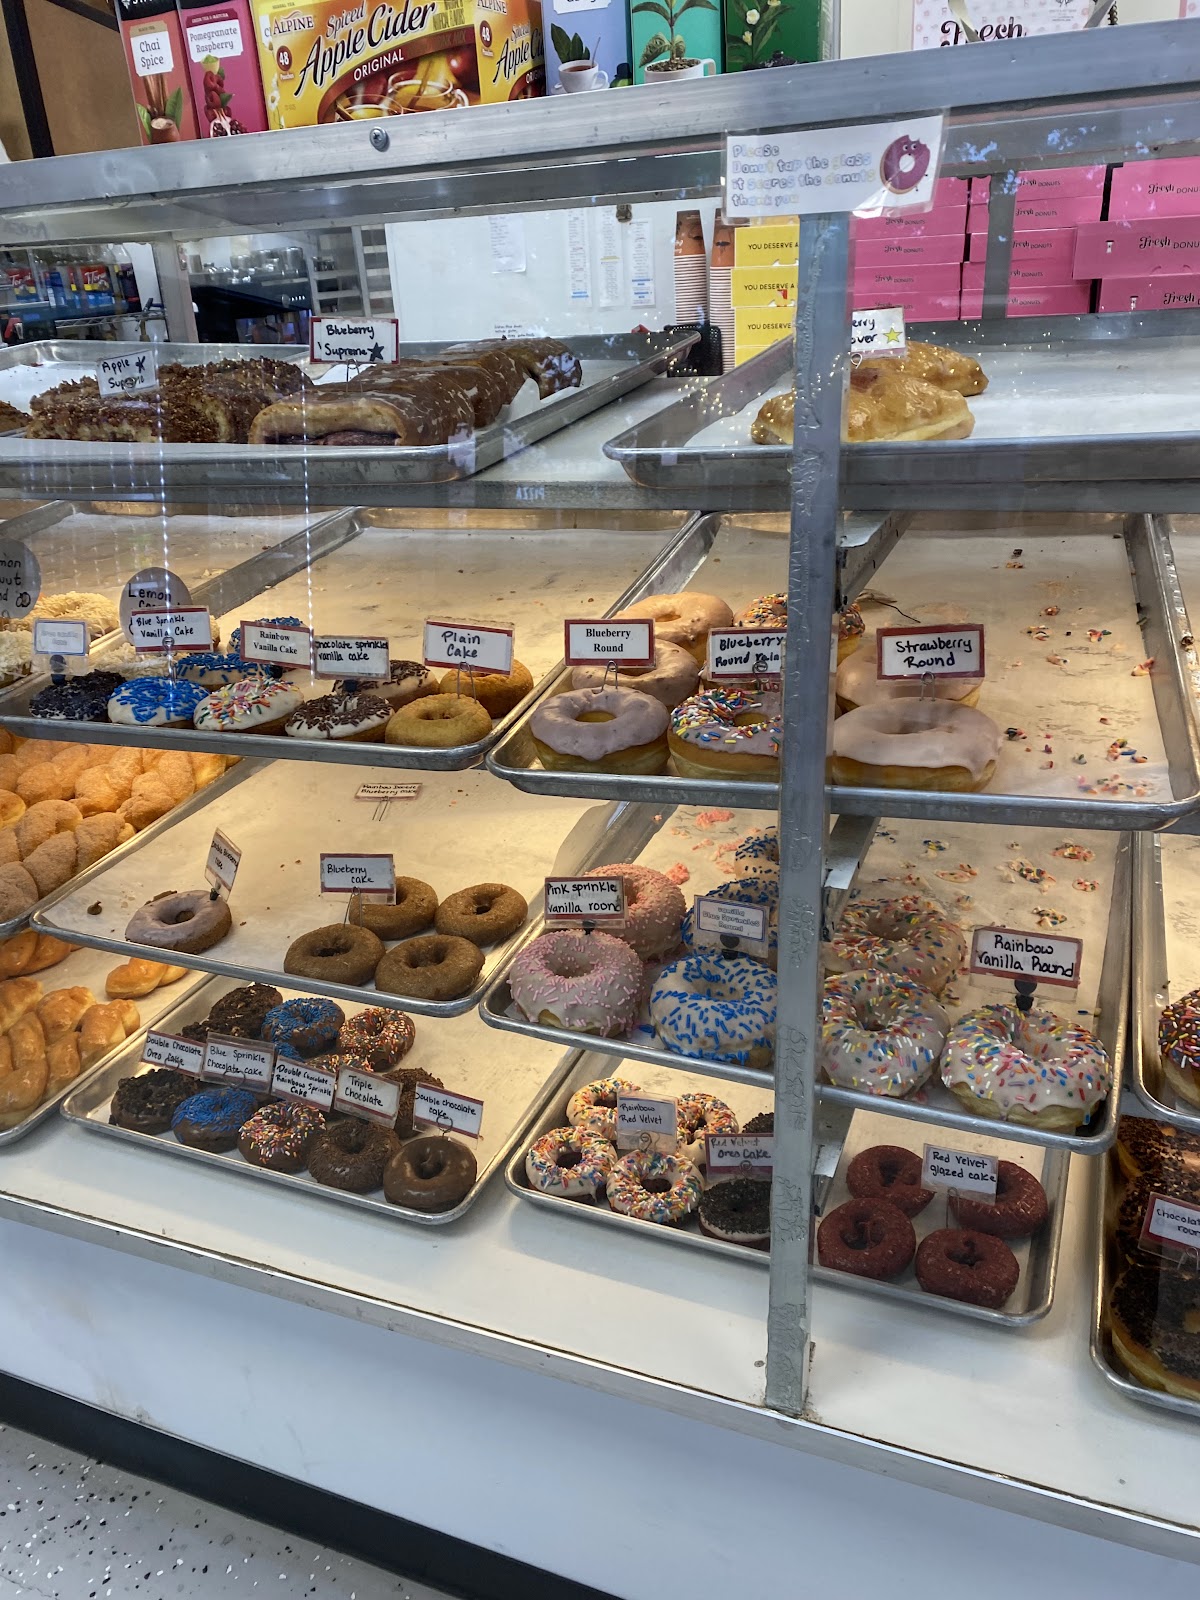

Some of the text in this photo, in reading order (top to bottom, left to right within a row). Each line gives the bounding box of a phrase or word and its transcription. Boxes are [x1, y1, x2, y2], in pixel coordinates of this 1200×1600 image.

[477, 0, 507, 14] ALPINE
[273, 16, 314, 35] ALPINE
[326, 2, 365, 39] Spiced
[190, 26, 238, 42] Pomegranate
[481, 26, 491, 42] 48
[140, 37, 161, 53] Chai
[196, 40, 234, 54] Raspberry
[294, 35, 365, 97] Apple
[367, 0, 436, 47] Cider
[140, 54, 164, 70] Spice
[279, 51, 290, 66] 48
[353, 48, 404, 82] ORIGINAL
[493, 37, 530, 83] Apple
[732, 144, 780, 158] Please
[732, 151, 872, 174] Donut tap the glass
[731, 168, 876, 191] it scares the donuts
[1147, 183, 1175, 195] Fresh
[731, 193, 800, 208] thank you
[1016, 207, 1034, 217] Fresh
[885, 216, 904, 226] Fresh
[747, 243, 763, 251] YOU
[763, 242, 793, 250] DESERVE
[884, 244, 903, 254] Fresh
[1139, 235, 1171, 250] Fresh
[1162, 291, 1196, 306] Fresh
[326, 323, 375, 340] Blueberry
[325, 342, 369, 360] Supreme
[101, 359, 130, 375] Apple
[128, 582, 172, 603] Lemon
[136, 614, 186, 627] Blue Sprinkle
[140, 625, 195, 639] Vanilla Cake
[259, 629, 291, 642] Rainbow
[441, 630, 481, 646] Plain
[586, 628, 631, 640] Blueberry
[253, 641, 298, 656] Vanilla Cake
[446, 644, 478, 659] Cake
[593, 643, 624, 653] Round
[719, 635, 784, 652] Blueberry
[895, 636, 973, 653] Strawberry
[318, 650, 370, 662] vanilla cake
[715, 651, 751, 668] Round
[903, 651, 956, 669] Round
[360, 788, 399, 796] Blueberry
[327, 863, 368, 876] Blueberry
[351, 875, 375, 885] cake
[546, 882, 570, 896] Pink
[572, 881, 618, 897] sprinkle
[548, 901, 583, 913] vanilla
[994, 934, 1054, 955] Rainbow
[978, 951, 1074, 978] Vanilla Round
[145, 1035, 202, 1057] Double Chocolate
[146, 1048, 162, 1061] Oreo
[209, 1045, 266, 1064] Blue Sprinkle
[207, 1058, 264, 1078] Chocolate cake
[276, 1064, 328, 1085] Double Chocolate
[275, 1074, 332, 1097] Rainbow Sprinkle
[348, 1074, 374, 1091] Triple
[290, 1086, 308, 1098] Cake
[344, 1086, 384, 1108] Chocolate
[415, 1091, 477, 1116] Double chocolate
[619, 1102, 656, 1113] Rainbow
[428, 1107, 449, 1120] cake
[619, 1113, 663, 1125] Red Velvet
[710, 1137, 761, 1149] Red Velvet
[717, 1148, 772, 1160] Oreo Cake
[932, 1151, 988, 1169] Red Velvet
[930, 1164, 997, 1183] glazed cake
